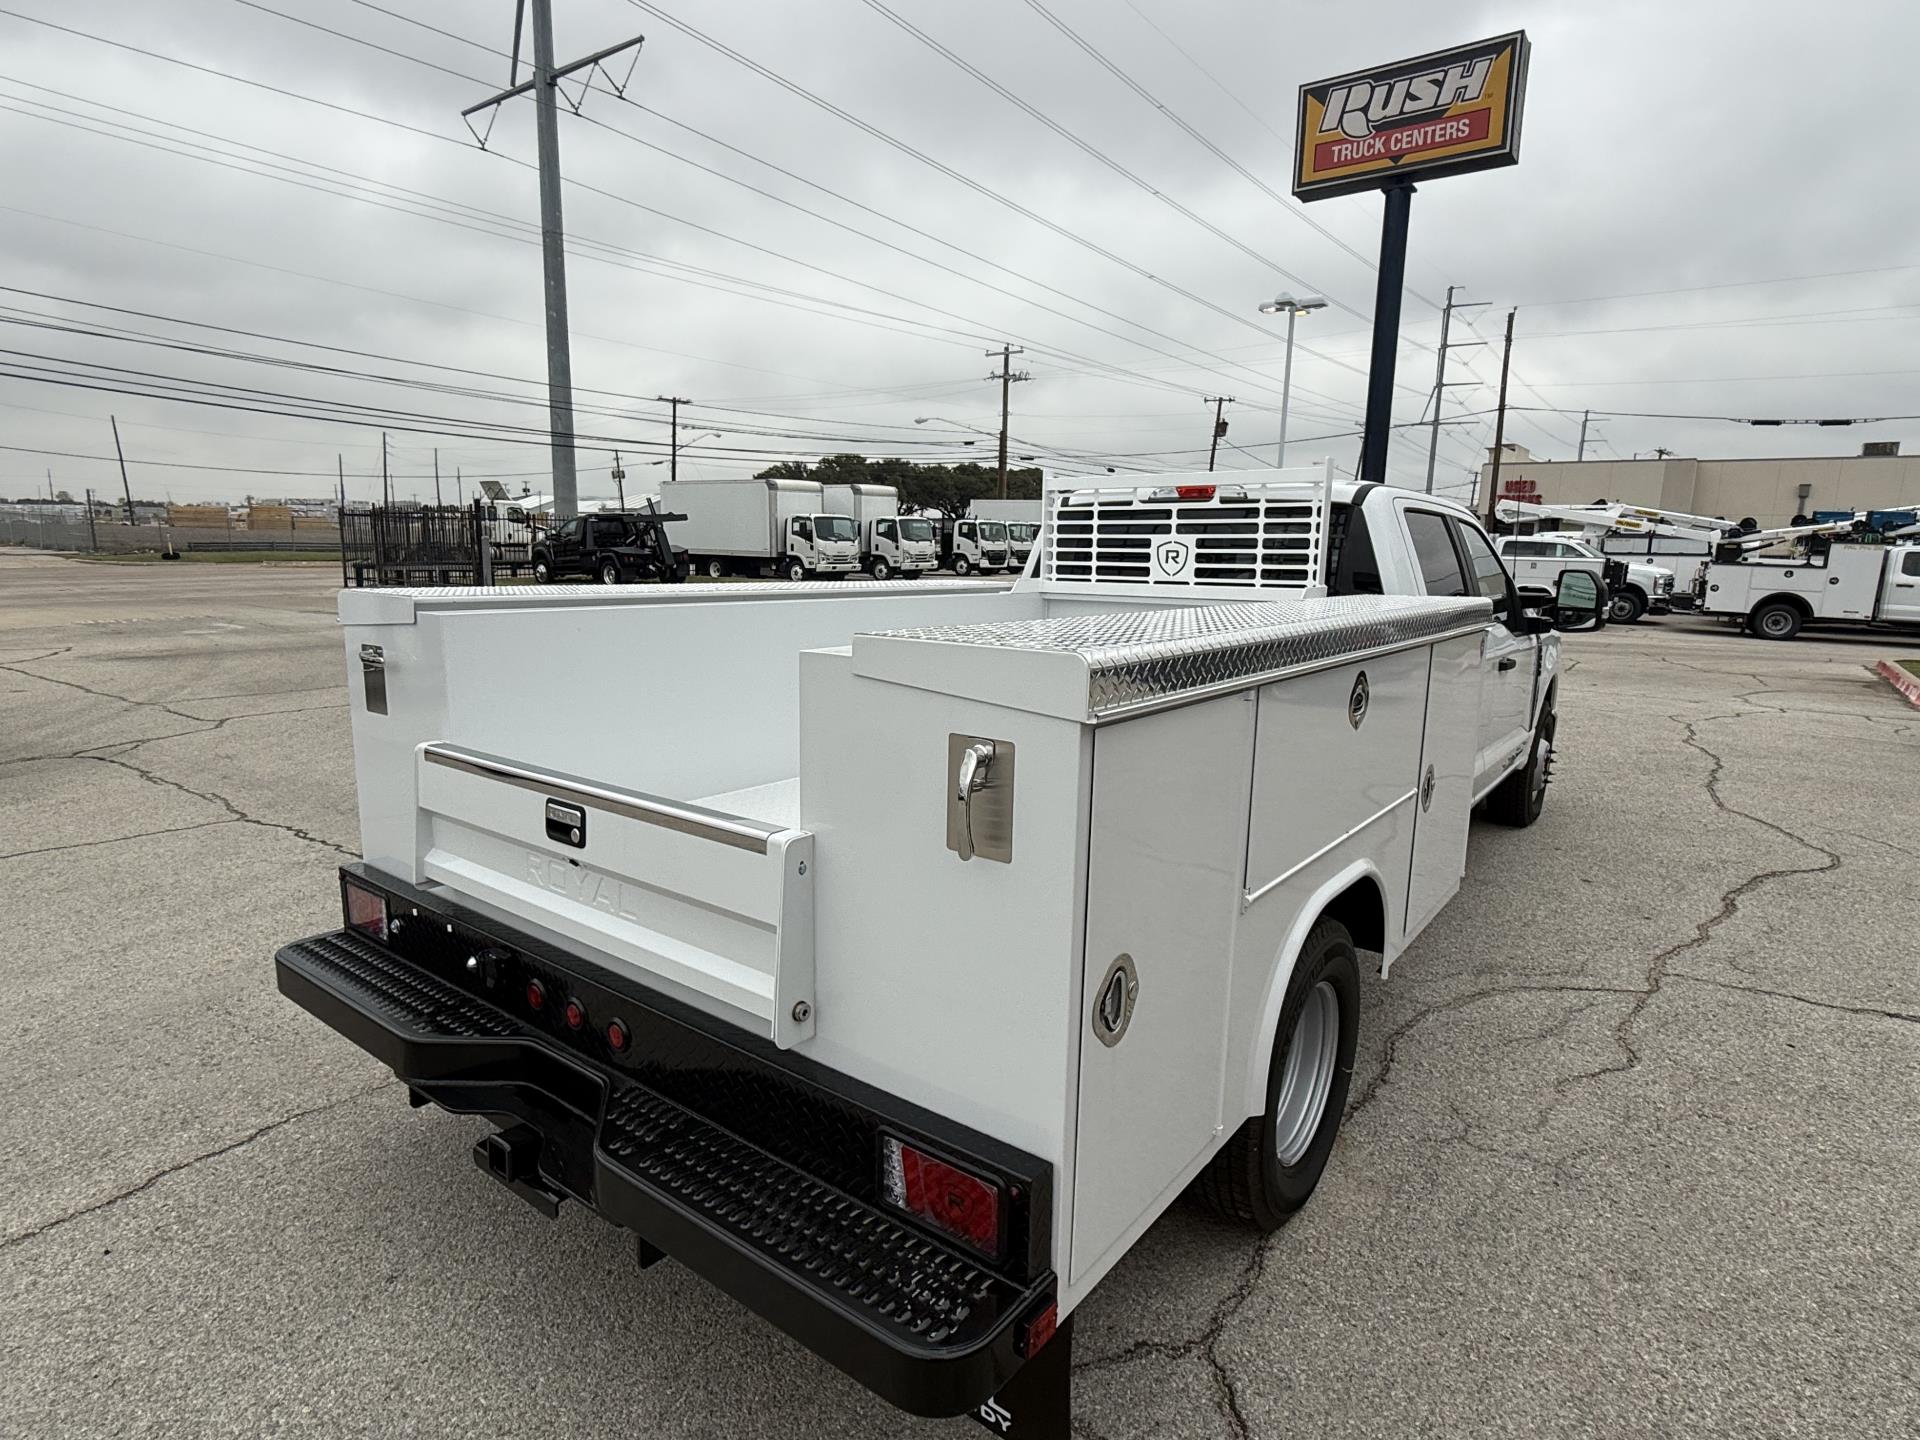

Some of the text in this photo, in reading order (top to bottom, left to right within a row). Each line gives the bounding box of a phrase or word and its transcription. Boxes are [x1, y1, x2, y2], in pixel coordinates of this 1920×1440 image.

[1318, 55, 1497, 140] RUSH
[1332, 118, 1470, 163] TRUCK CENTERS
[1505, 480, 1536, 493] USED
[1165, 549, 1180, 564] R
[526, 851, 638, 920] ROYAL
